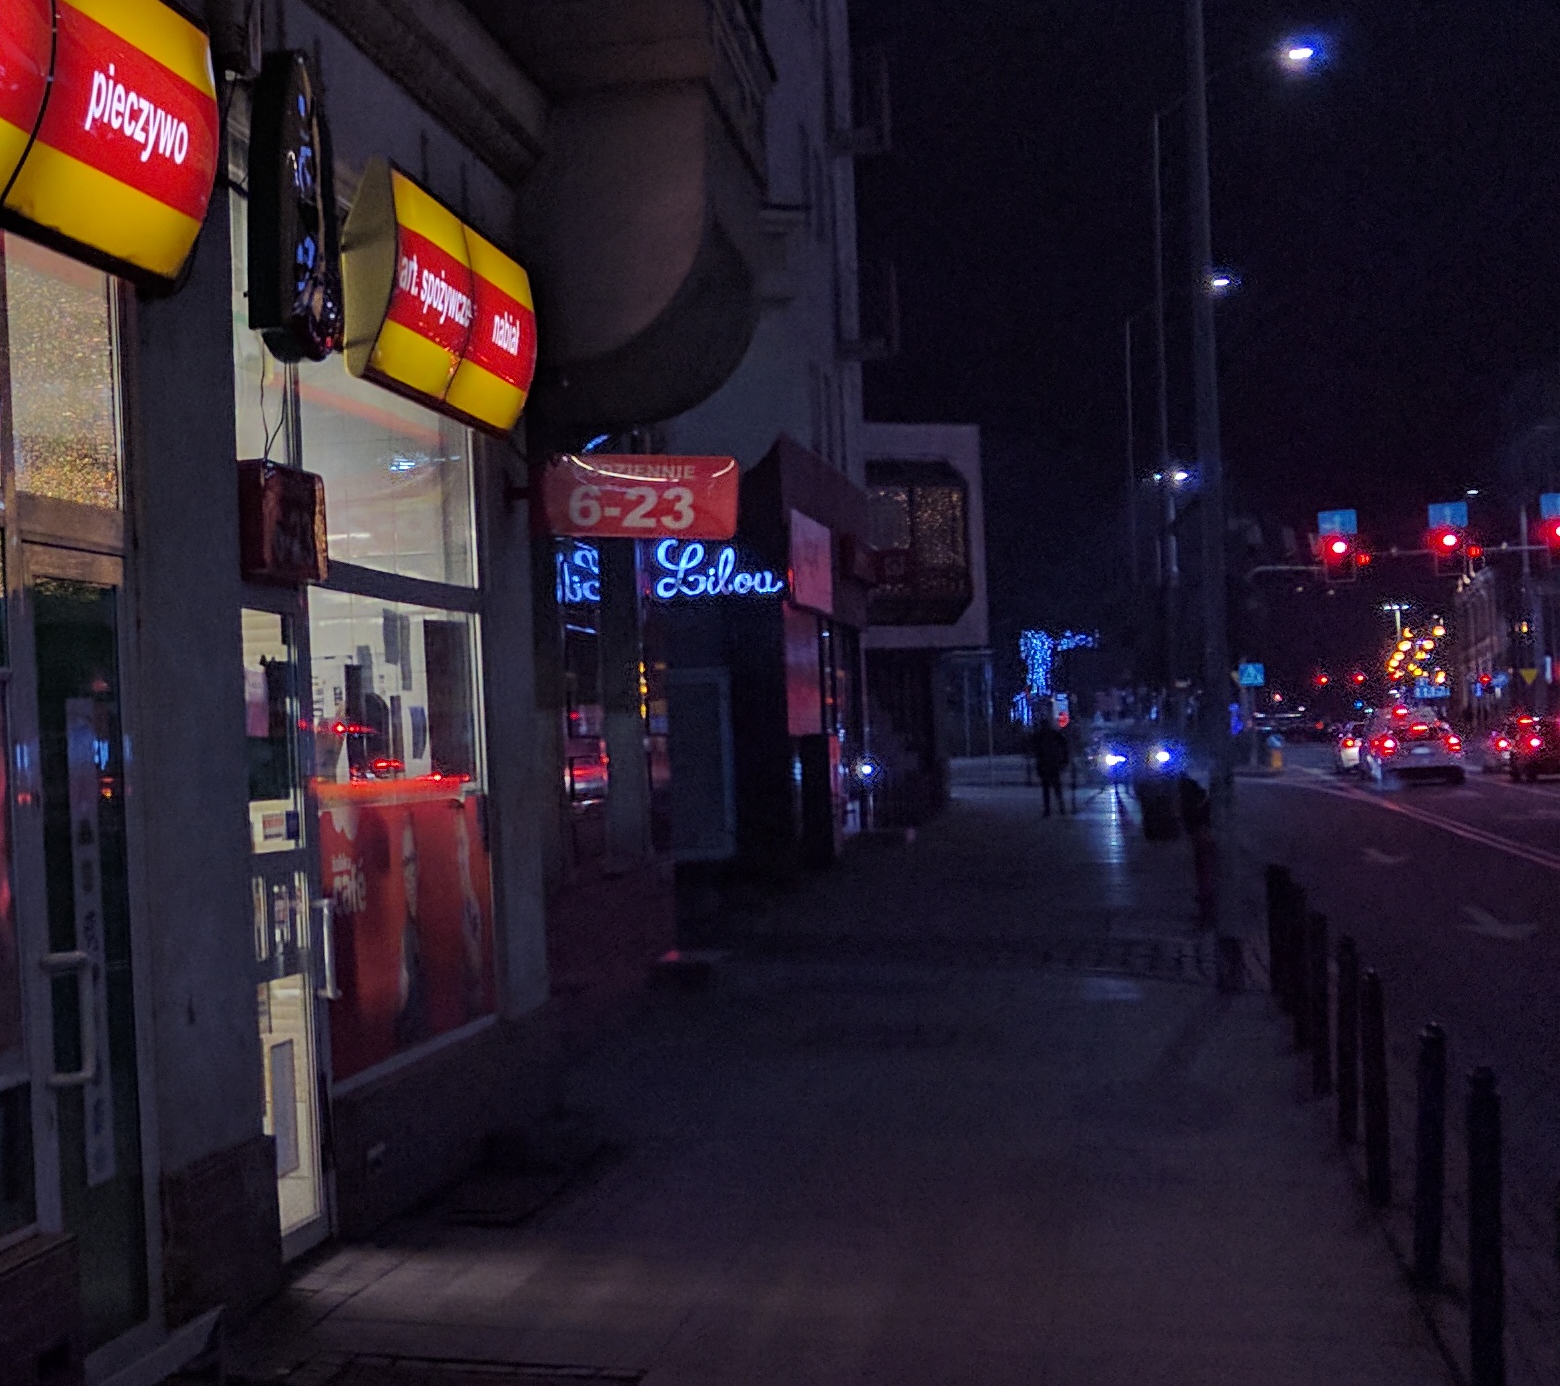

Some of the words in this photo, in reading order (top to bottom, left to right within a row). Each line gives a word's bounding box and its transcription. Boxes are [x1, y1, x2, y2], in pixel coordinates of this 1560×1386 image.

[85, 65, 189, 165] pieczywo
[568, 485, 696, 530] 6-23
[656, 538, 784, 599] Lilou
